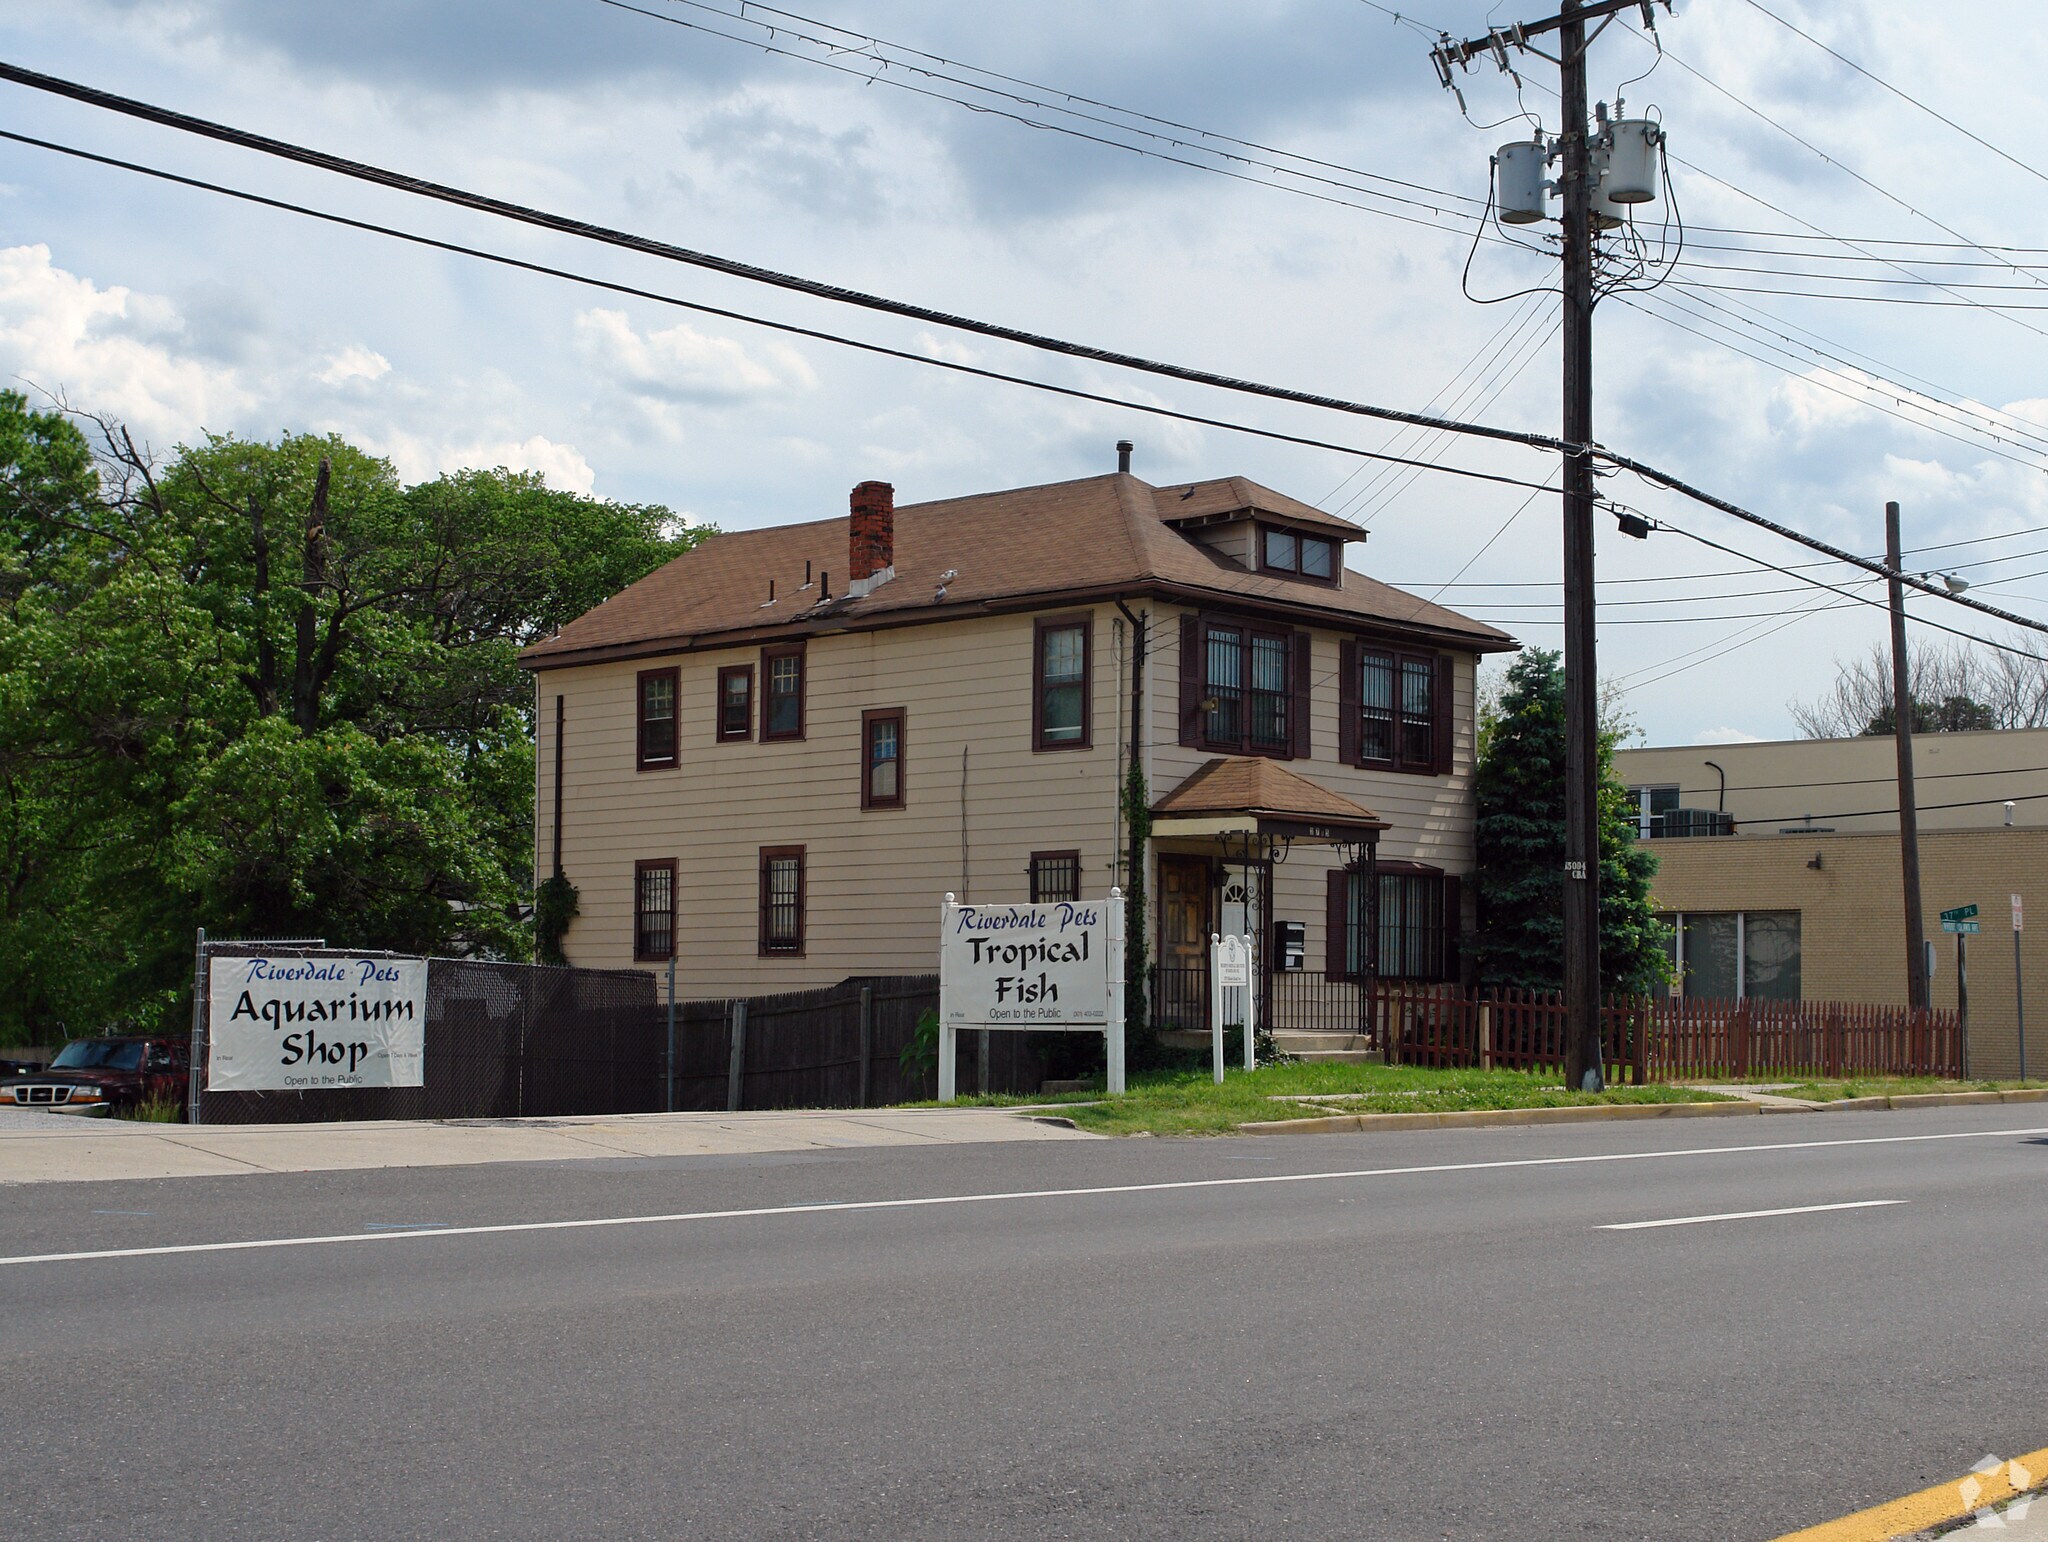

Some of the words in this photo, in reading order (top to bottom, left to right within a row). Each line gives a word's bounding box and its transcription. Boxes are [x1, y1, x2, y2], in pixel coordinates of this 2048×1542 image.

[957, 907, 1046, 934] Riverdale
[1054, 902, 1097, 933] Pets
[1964, 906, 1975, 916] PL
[965, 930, 1089, 971] Tropical
[247, 958, 345, 983] Riverdale
[356, 960, 400, 986] Pets
[995, 972, 1058, 1004] Fish
[230, 990, 414, 1030] Aquarium
[989, 1008, 1011, 1020] Open
[1013, 1009, 1021, 1019] to
[1023, 1008, 1035, 1019] the
[1038, 1007, 1061, 1019] Public
[281, 1029, 368, 1072] Shop
[284, 1076, 308, 1086] Open
[311, 1075, 319, 1084] to
[322, 1074, 335, 1084] the
[338, 1074, 362, 1084] Public
